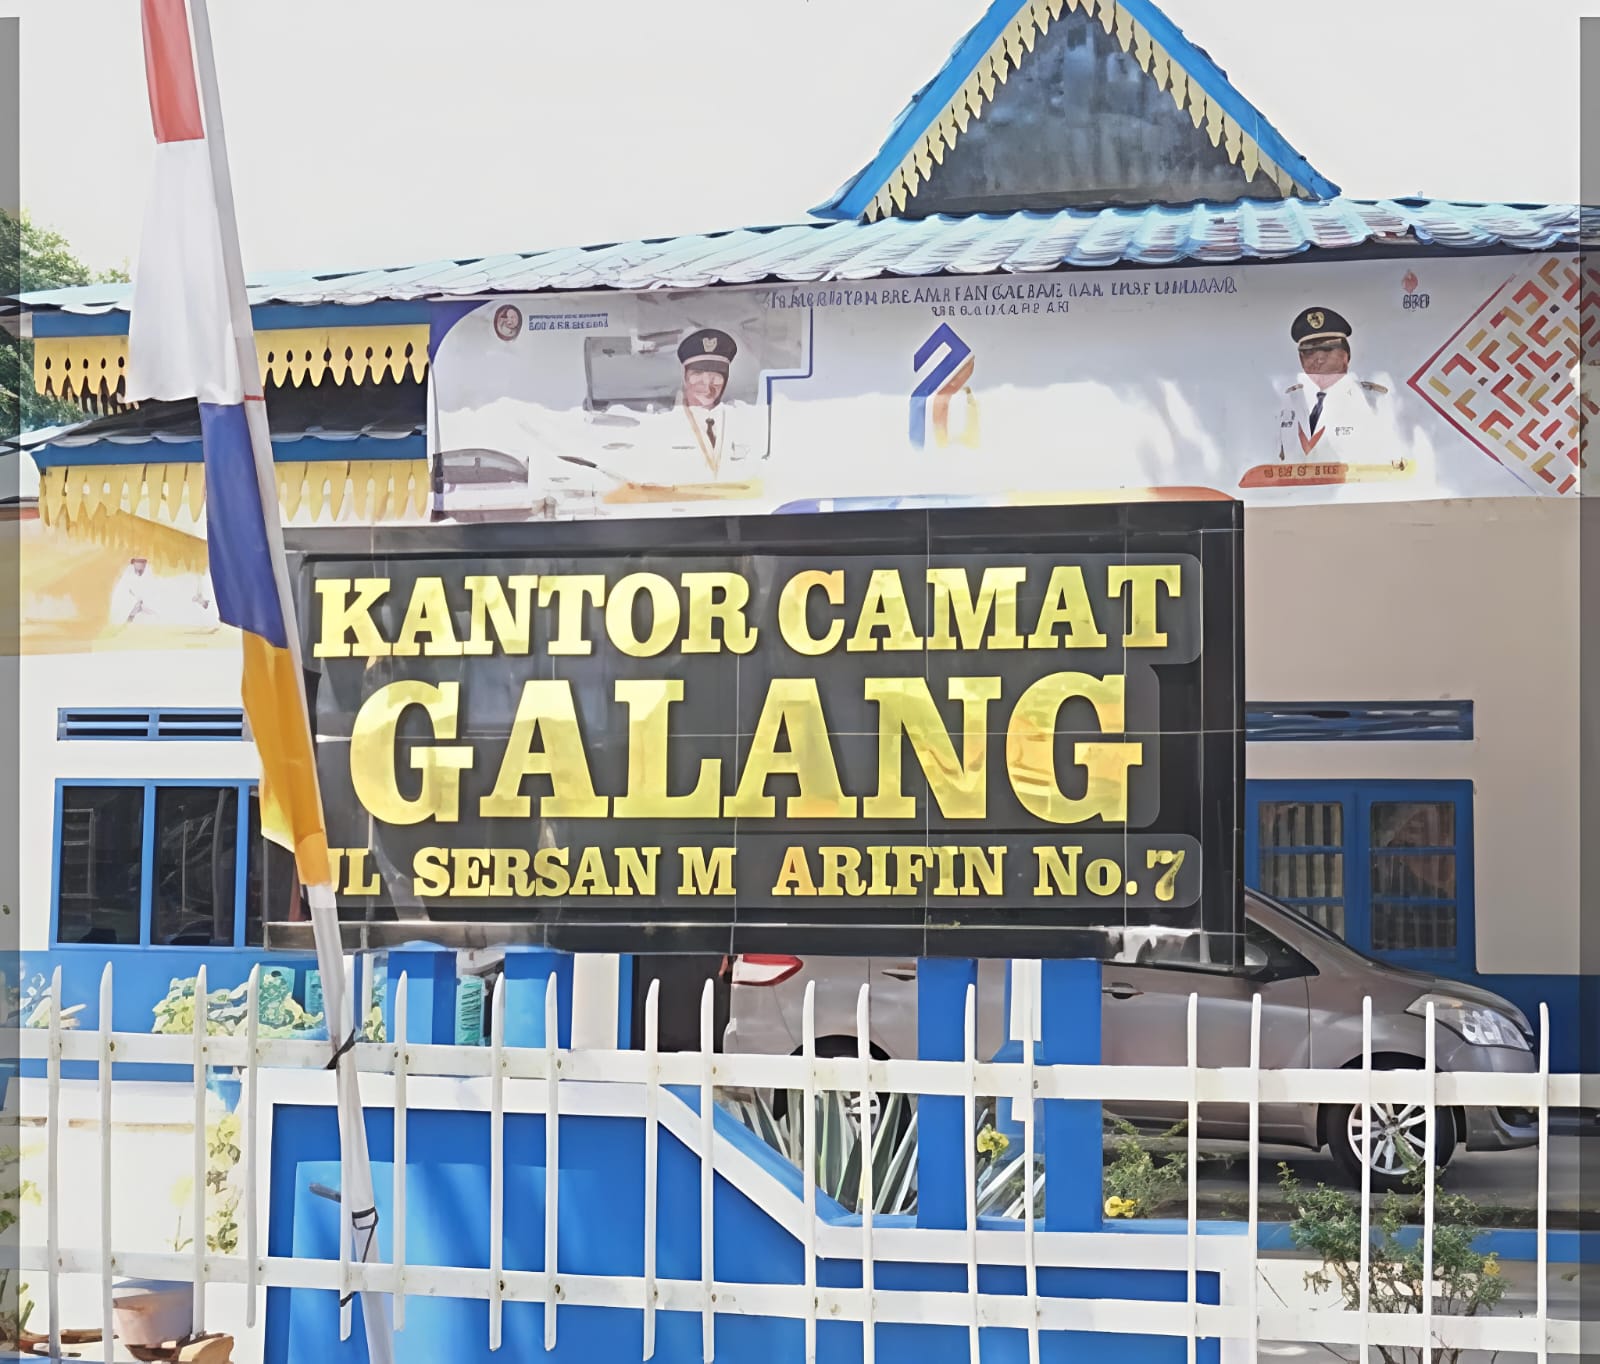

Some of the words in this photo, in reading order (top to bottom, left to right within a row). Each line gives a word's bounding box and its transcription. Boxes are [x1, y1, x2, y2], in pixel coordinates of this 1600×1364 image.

[315, 573, 758, 660] KANTOR
[779, 565, 1180, 655] CAMAT
[350, 672, 1142, 824] GALANG
[413, 847, 661, 896] SERSAN
[678, 847, 736, 895] M
[772, 846, 1007, 896] ARIFIN
